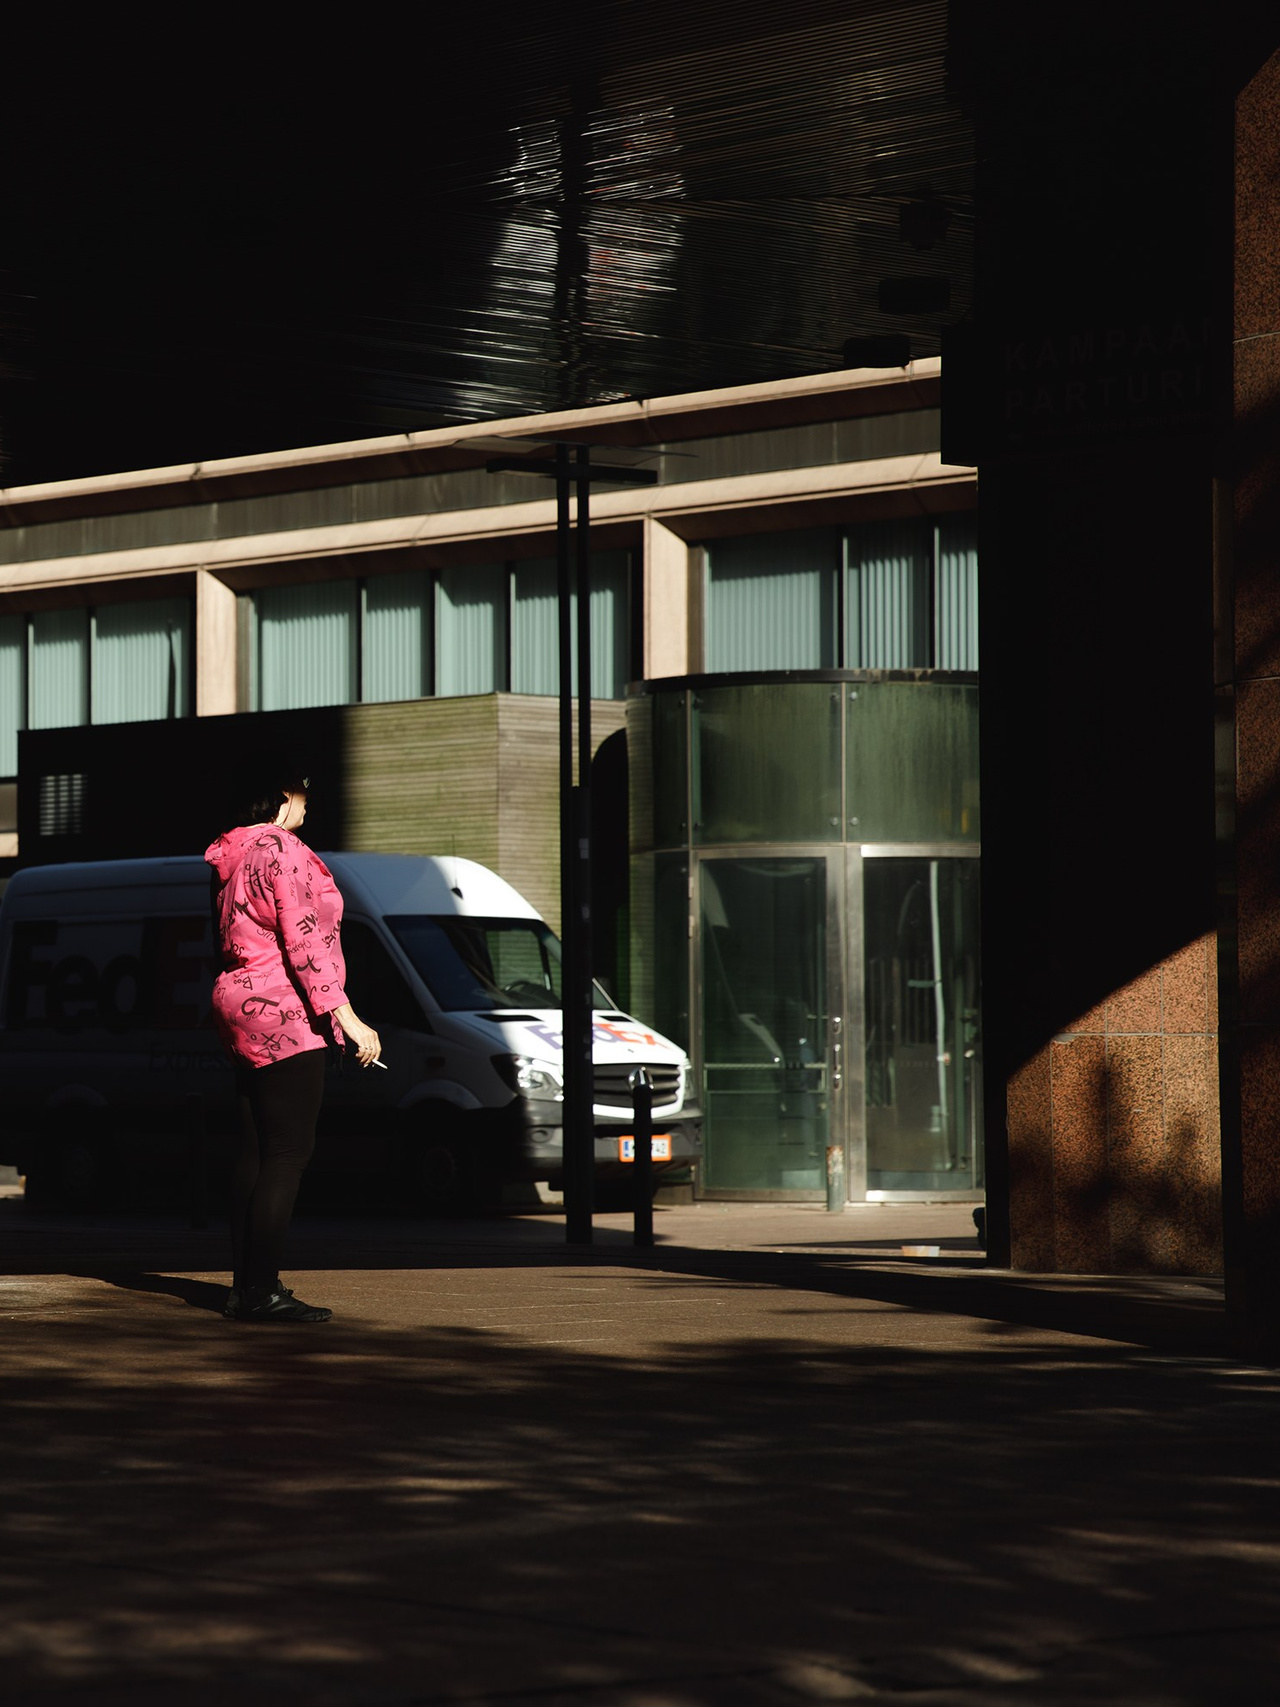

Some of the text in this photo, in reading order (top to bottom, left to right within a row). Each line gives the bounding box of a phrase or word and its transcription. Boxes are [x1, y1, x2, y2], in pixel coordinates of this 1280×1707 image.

[1004, 366, 1203, 419] PARTURI
[10, 916, 216, 1035] FedE
[524, 1024, 669, 1050] FdEx
